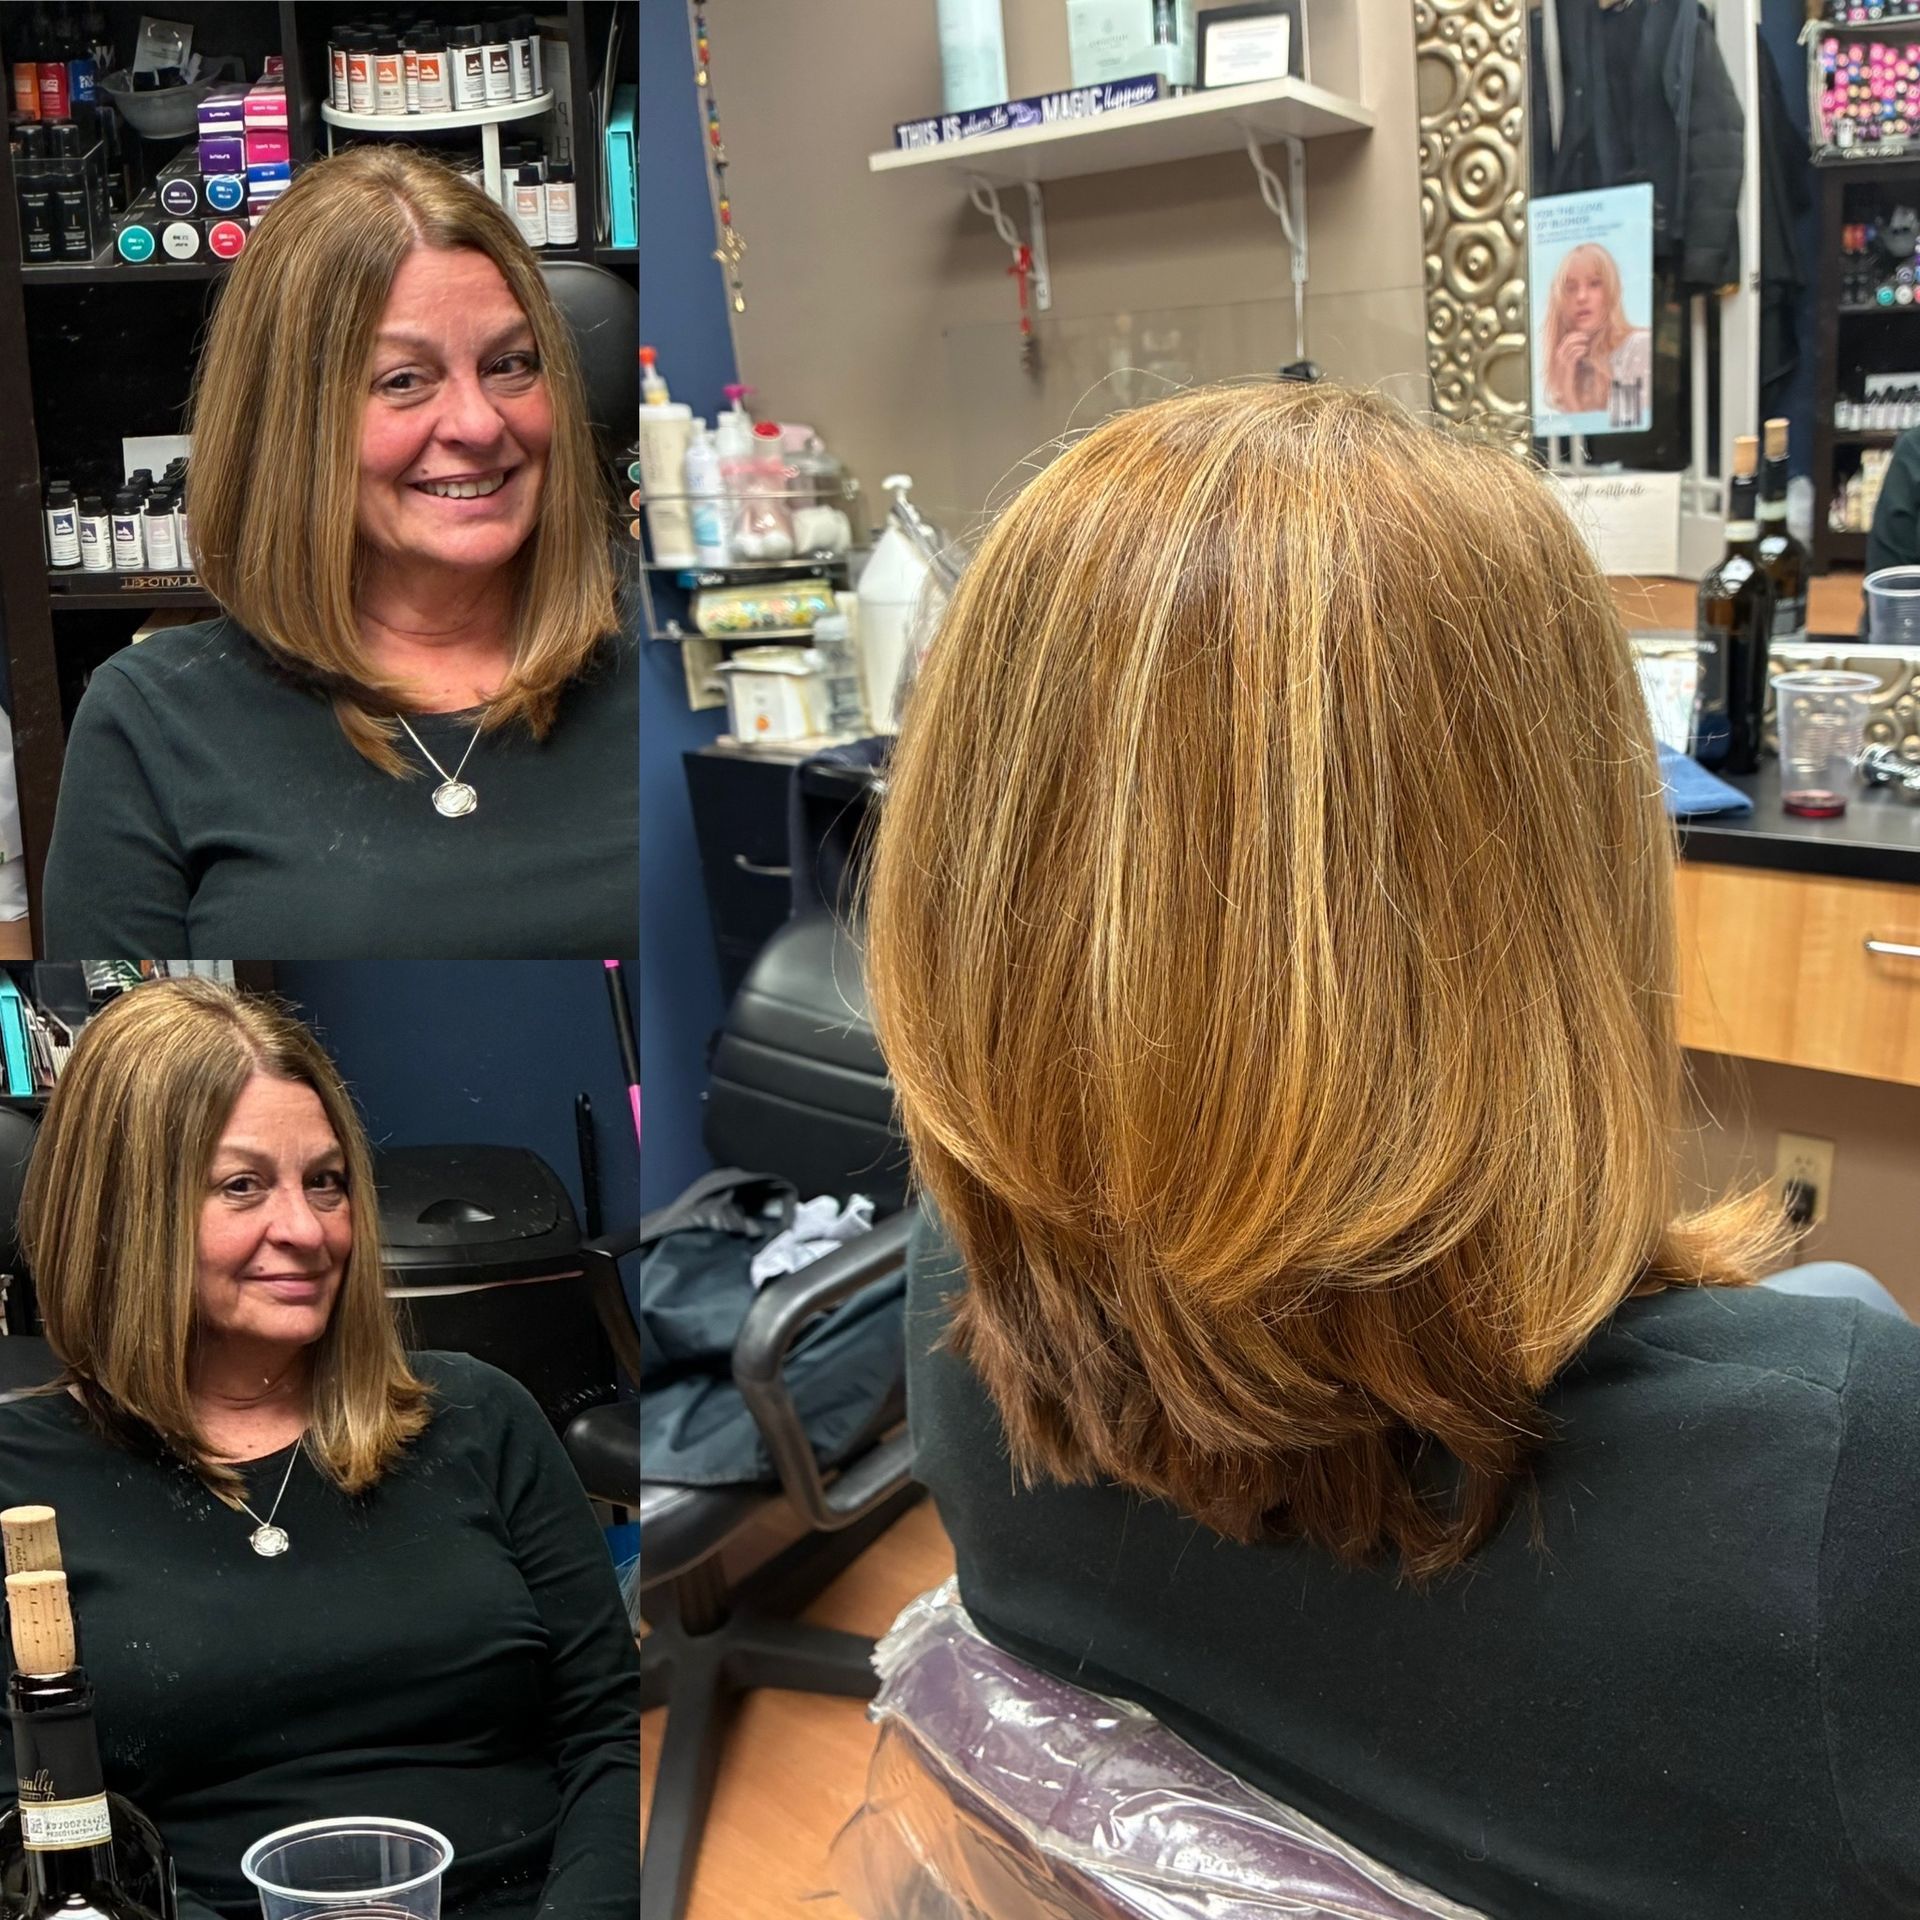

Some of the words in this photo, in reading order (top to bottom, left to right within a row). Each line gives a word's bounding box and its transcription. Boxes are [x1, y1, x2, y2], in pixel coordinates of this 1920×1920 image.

[897, 119, 940, 150] THIS
[941, 115, 961, 142] IS
[1041, 86, 1104, 122] MAGIC
